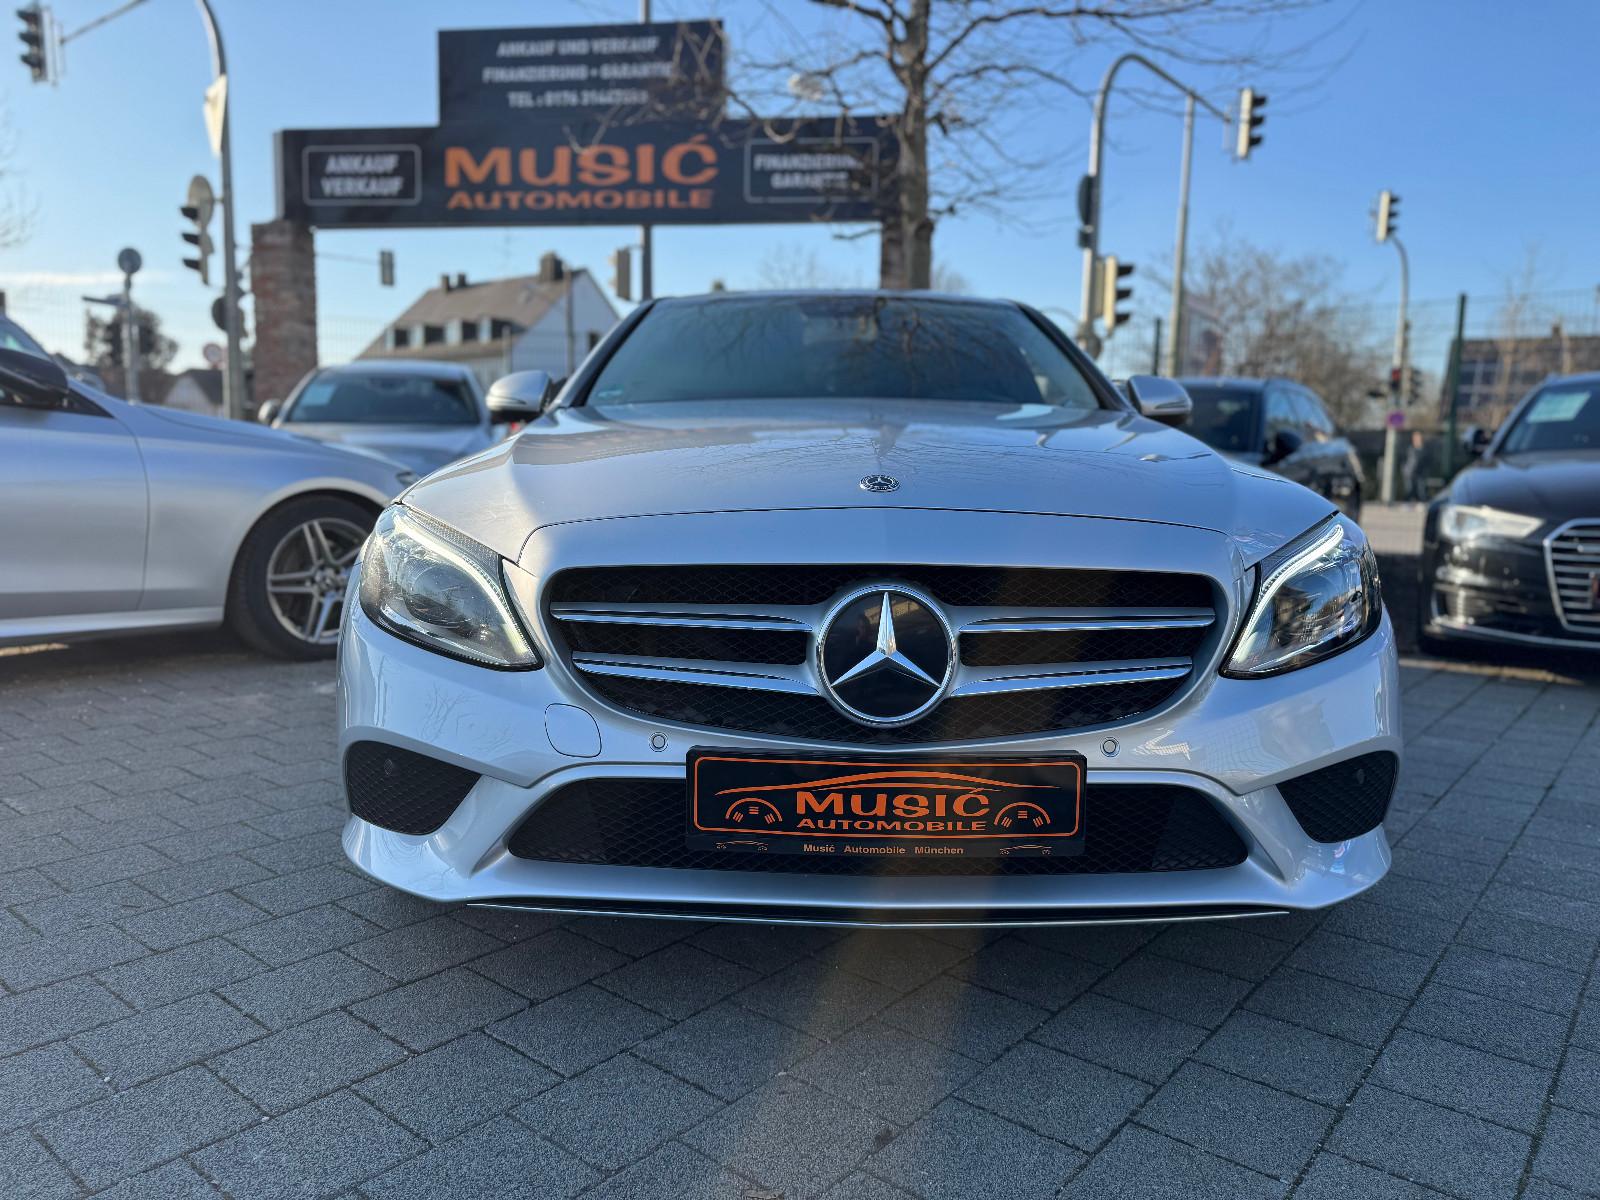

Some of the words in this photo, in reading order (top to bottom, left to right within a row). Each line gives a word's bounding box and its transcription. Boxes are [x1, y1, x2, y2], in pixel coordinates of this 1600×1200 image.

[497, 40, 556, 57] ANKAUF
[558, 38, 589, 55] UND
[592, 36, 659, 54] VERKAUF
[482, 64, 588, 83] FINANZIERUNG
[325, 154, 399, 174] ANKAUF
[444, 134, 719, 188] MUSIĆ
[320, 176, 403, 197] VERKAUF
[447, 188, 714, 210] AUTOMOBILE
[796, 787, 990, 818] MUSIĆ
[796, 817, 987, 832] AUTOMOBILE
[803, 843, 835, 853] Musić
[843, 845, 906, 855] Automobile
[914, 846, 964, 855] München
